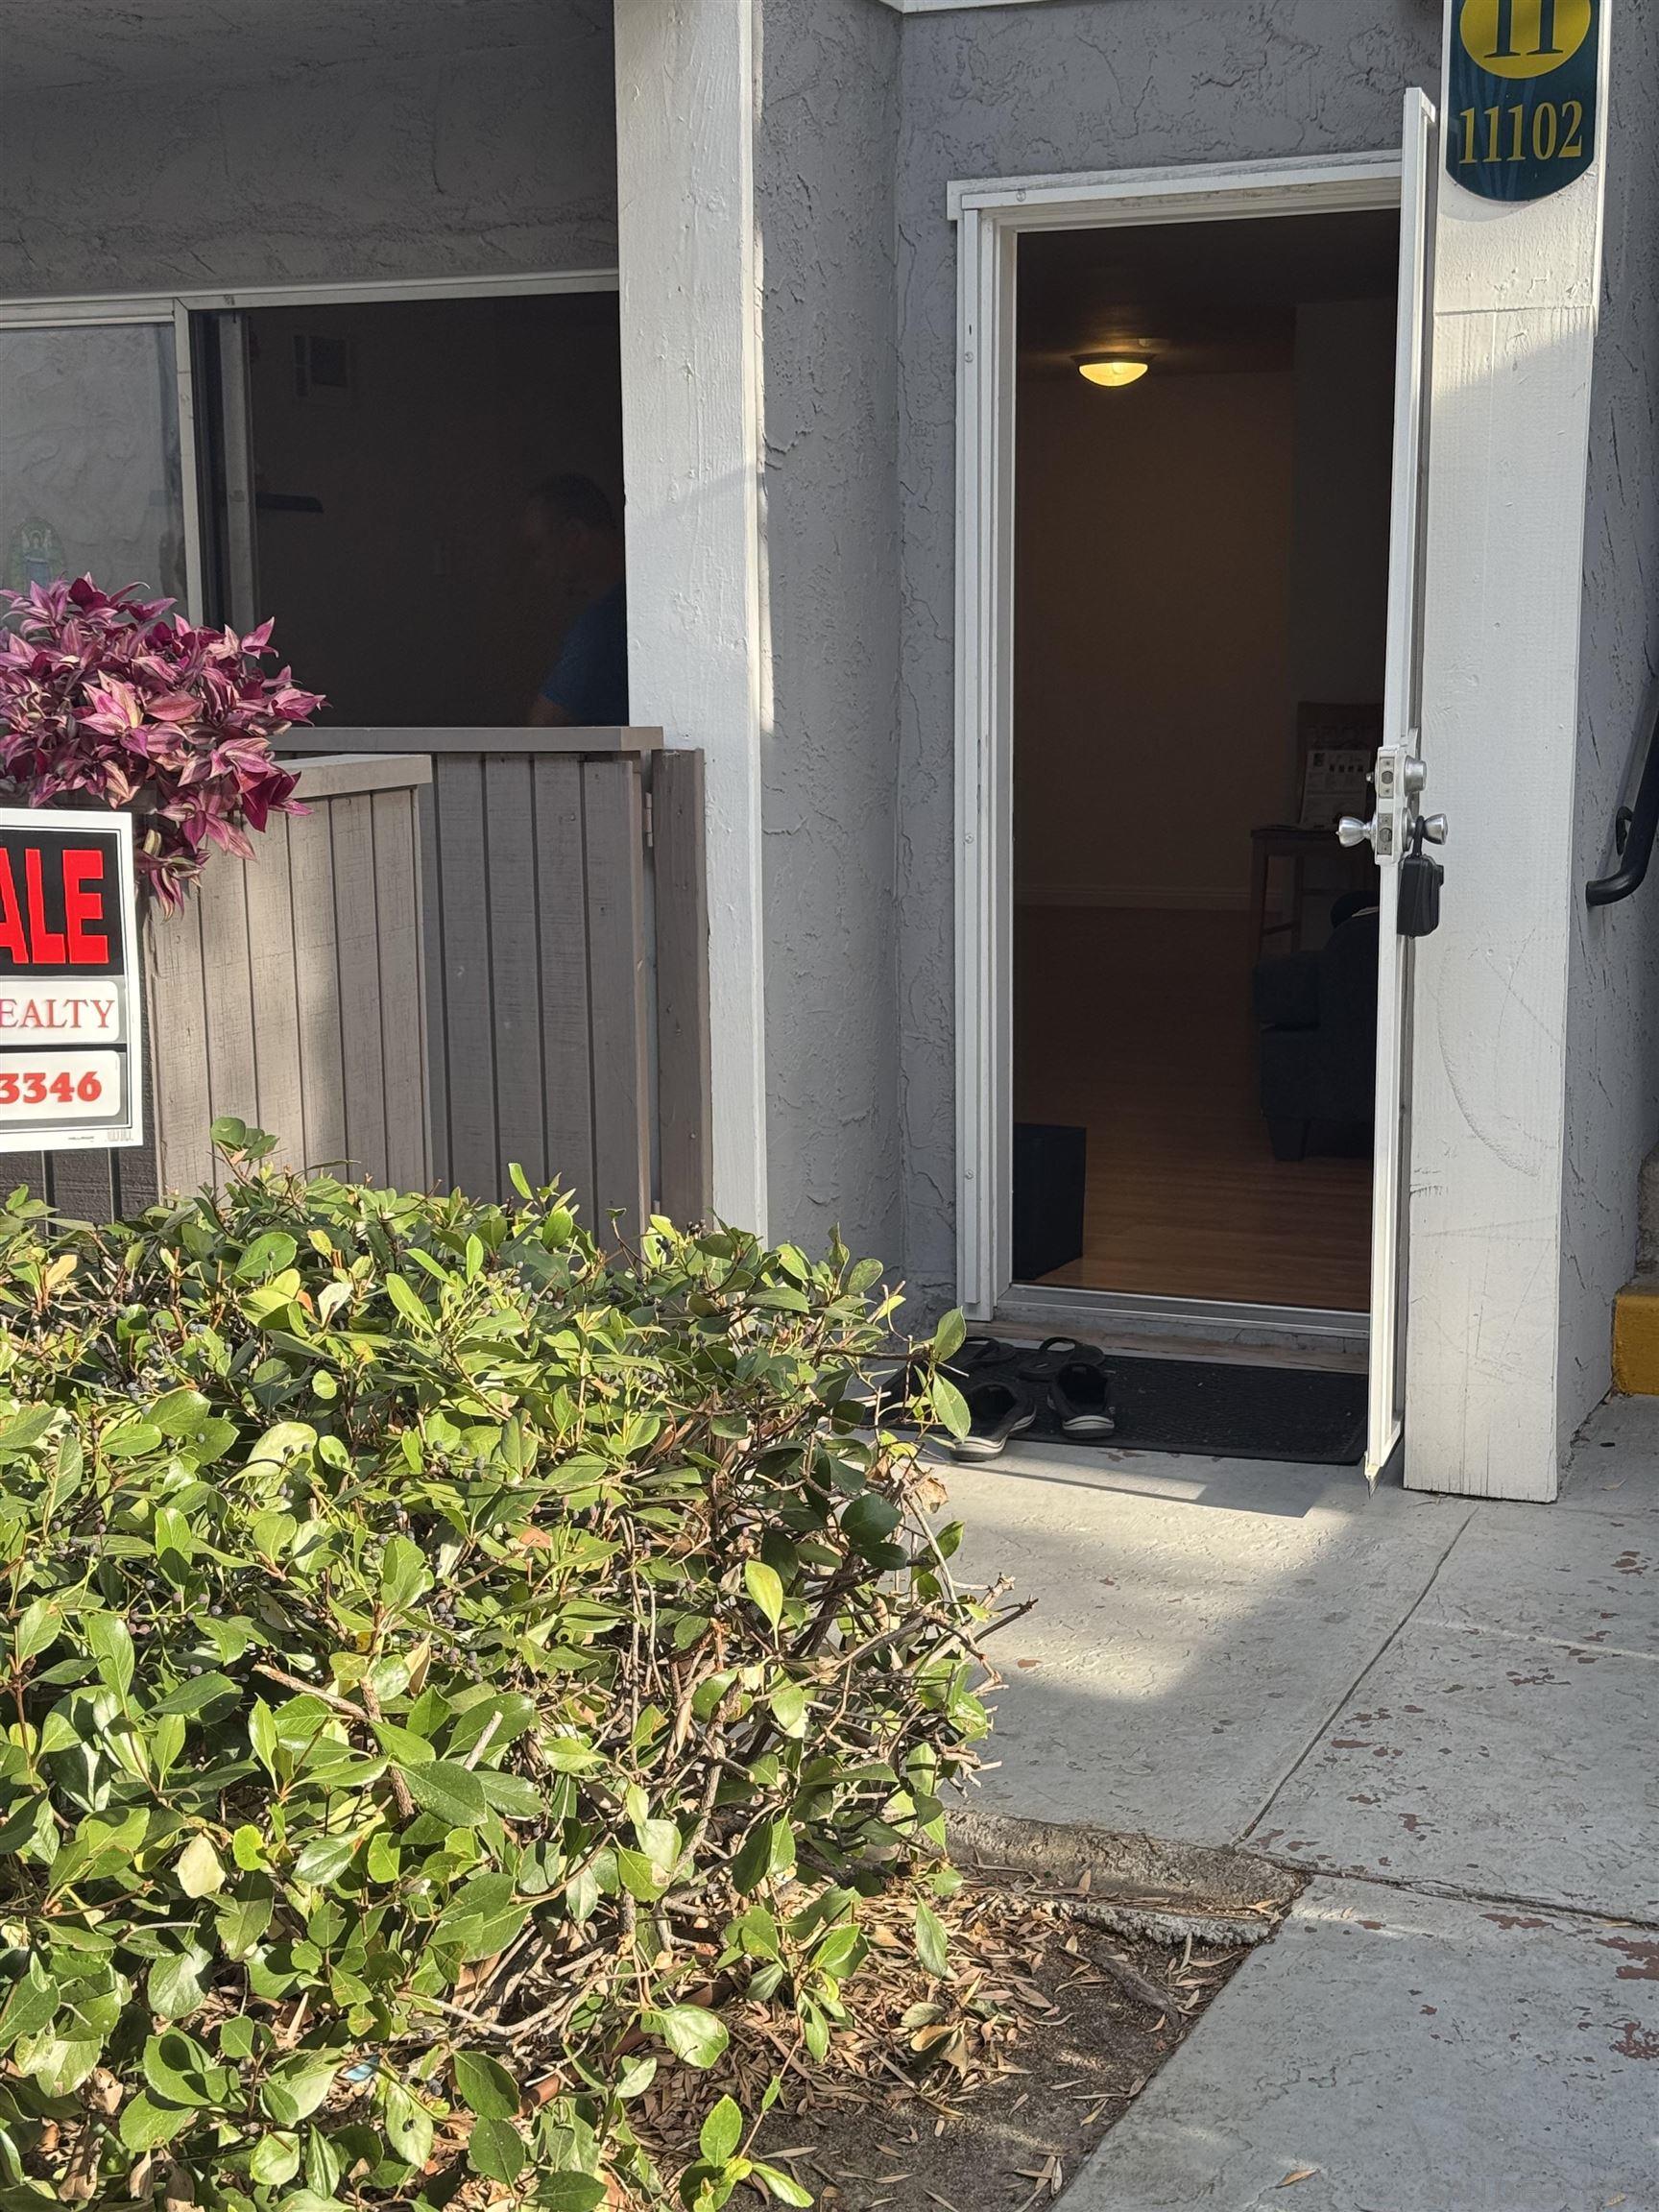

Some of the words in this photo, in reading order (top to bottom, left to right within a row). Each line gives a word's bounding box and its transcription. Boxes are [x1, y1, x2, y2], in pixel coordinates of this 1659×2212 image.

[1459, 101, 1582, 164] 11102
[0, 999, 114, 1028] EALTY
[0, 1071, 102, 1103] 3346
